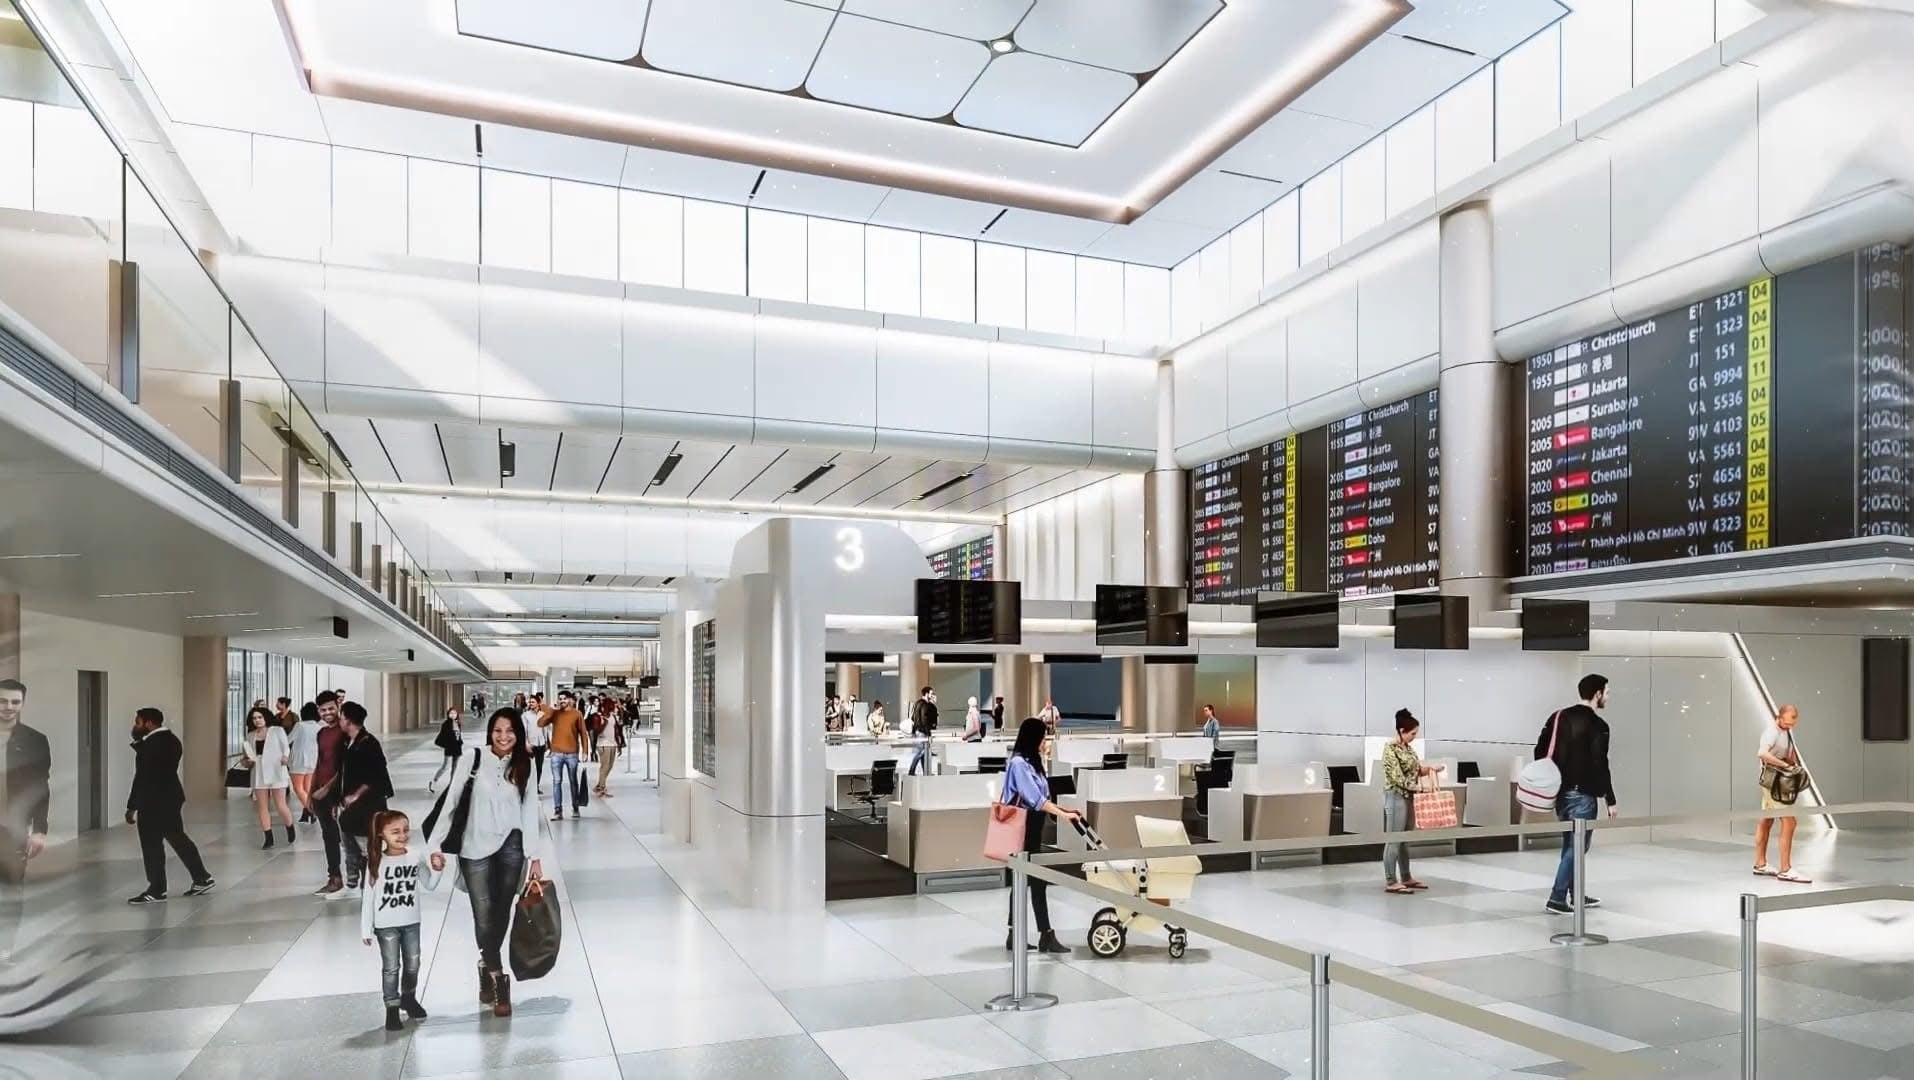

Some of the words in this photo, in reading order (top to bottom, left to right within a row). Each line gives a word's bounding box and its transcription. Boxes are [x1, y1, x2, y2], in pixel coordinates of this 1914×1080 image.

[1532, 352, 1552, 368] 1950
[1591, 320, 1656, 351] Christchurch
[1715, 291, 1742, 312] 1321
[1752, 282, 1767, 299] 04
[1532, 373, 1552, 390] 1955
[1716, 315, 1743, 336] 1323
[1752, 309, 1767, 325] 04
[1591, 376, 1628, 396] Jakarta
[1715, 342, 1735, 360] 151
[1752, 336, 1766, 350] 01
[1428, 390, 1437, 402] ET
[1531, 415, 1552, 432] 2005
[1689, 376, 1707, 392] GA
[1752, 362, 1766, 376] 11
[1428, 409, 1437, 421] ET
[1531, 437, 1552, 453] 2005
[1591, 419, 1642, 440] Bangalore
[1714, 390, 1742, 411] 5536
[1751, 387, 1765, 402] 04
[1428, 447, 1440, 459] GA
[1531, 458, 1552, 475] 2020
[1591, 445, 1627, 463] Jakarta
[1713, 416, 1742, 434] 4103
[1751, 412, 1765, 427] 05
[1428, 466, 1440, 478] VA
[1531, 480, 1552, 495] 2020
[1713, 441, 1741, 460] 5561
[1751, 438, 1765, 453] 04
[1531, 501, 1552, 515] 2025
[1591, 490, 1617, 504] Doha
[1713, 466, 1742, 484] 4654
[1751, 463, 1765, 478] 08
[1428, 504, 1439, 515] VA
[1531, 521, 1552, 536] 2025
[1713, 491, 1741, 509] 5657
[1750, 489, 1765, 503] 04
[835, 528, 864, 570] 3
[1428, 541, 1439, 553] VA
[1531, 542, 1552, 557] 2025
[1713, 515, 1741, 532] 4323
[1750, 514, 1765, 528] 02
[1154, 774, 1165, 791] 2
[1304, 768, 1315, 785] 3
[385, 865, 418, 880] LOVE
[384, 880, 416, 895] NEW
[378, 894, 414, 911] YORK
